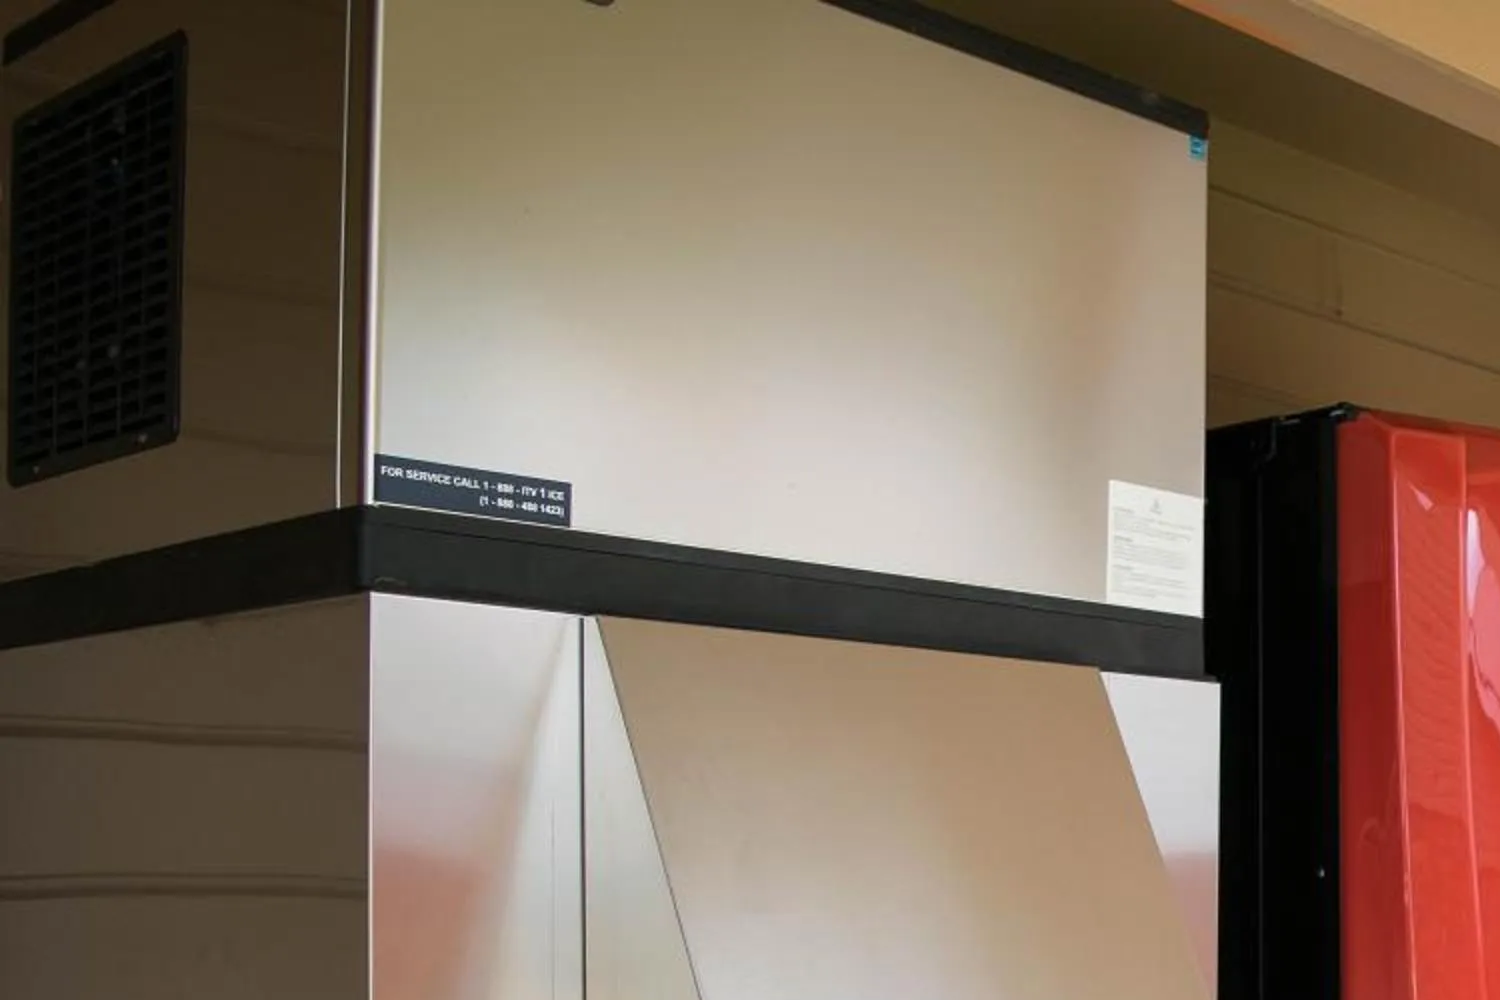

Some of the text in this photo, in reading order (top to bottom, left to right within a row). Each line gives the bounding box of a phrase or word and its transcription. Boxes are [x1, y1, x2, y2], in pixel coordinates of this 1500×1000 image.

[381, 465, 403, 479] FOR
[405, 469, 452, 486] SERVICE
[453, 476, 481, 489] CALL
[483, 481, 489, 491] 1
